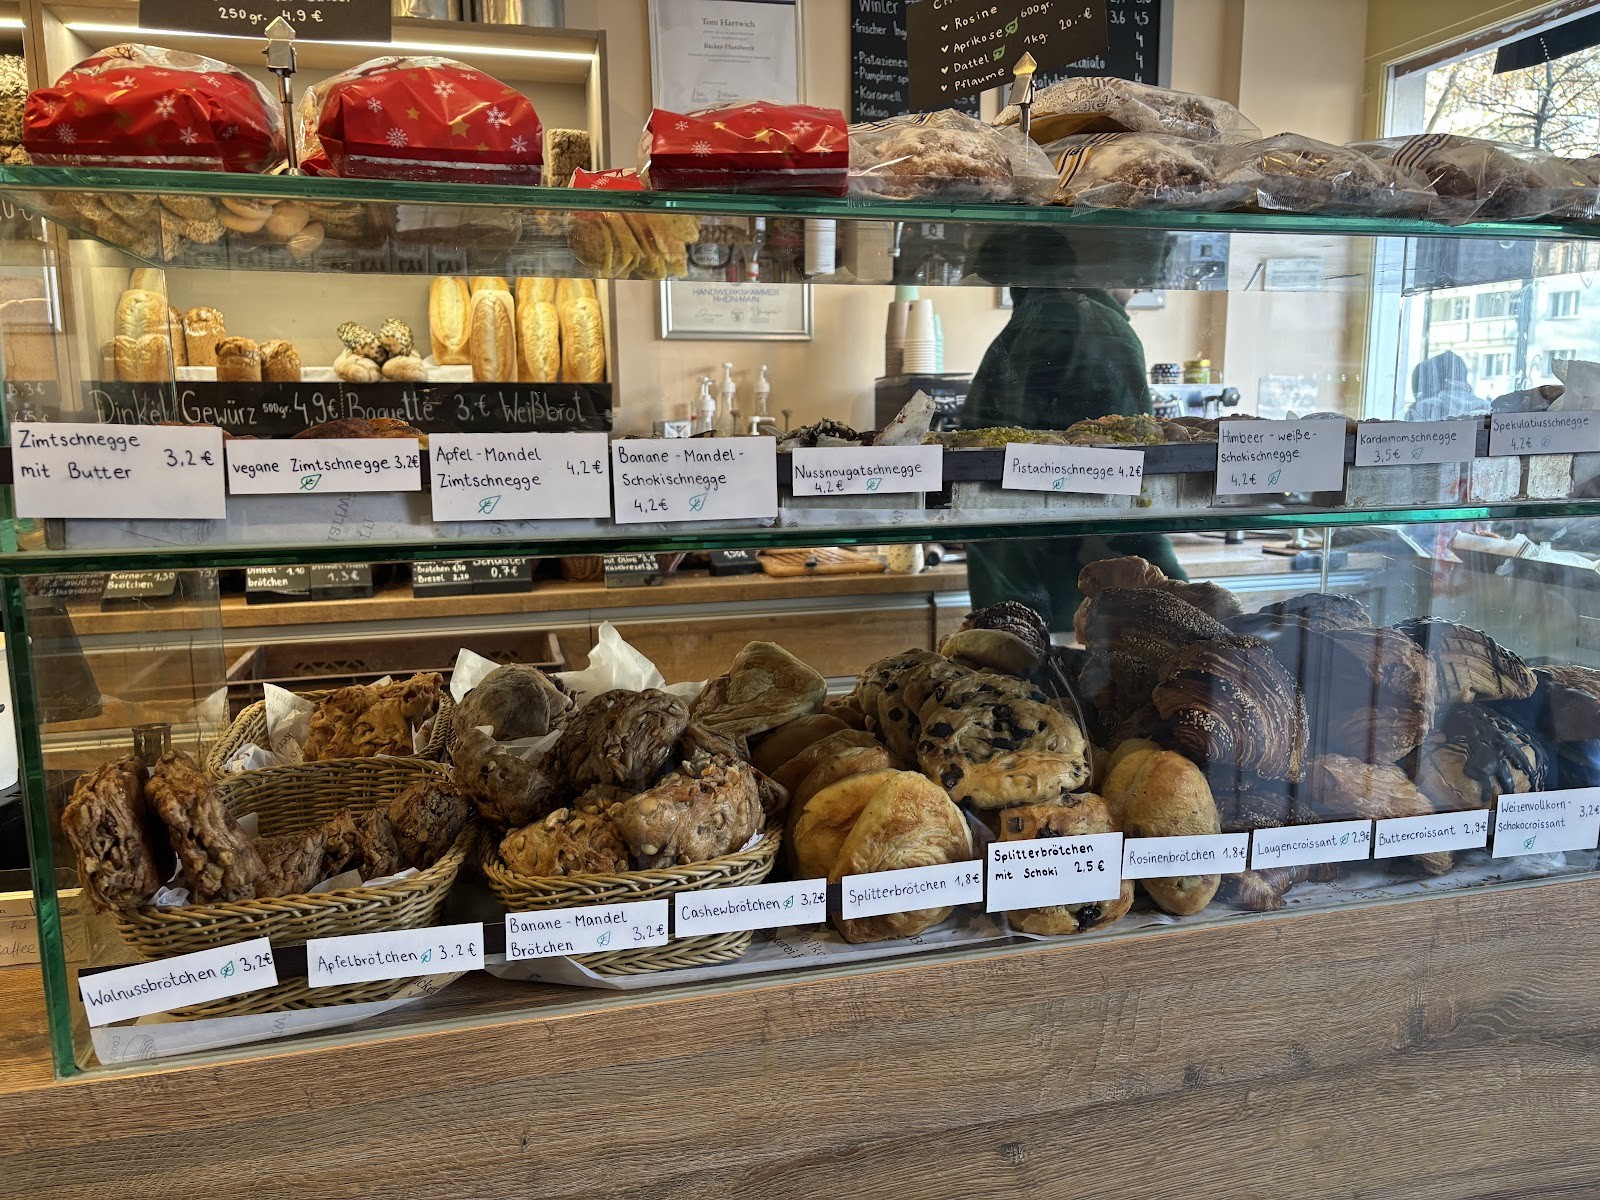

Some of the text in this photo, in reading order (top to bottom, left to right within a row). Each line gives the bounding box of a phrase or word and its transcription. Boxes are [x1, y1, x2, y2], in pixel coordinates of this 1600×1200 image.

[701, 17, 756, 28] Tom Hartwich
[955, 6, 998, 29] Rosine
[954, 28, 1003, 54] Aprikose
[1136, 31, 1144, 48] 4
[954, 53, 990, 73] Dattel
[1136, 52, 1144, 69] 4
[955, 67, 1005, 91] Pflaume
[692, 288, 779, 296] HANDWERKSKAMMER
[180, 390, 258, 425] Gewürz
[499, 391, 587, 424] Weißbrot
[1493, 416, 1589, 433] Spekulatiusschnegge
[18, 429, 141, 451] Zimtschnegge
[1360, 431, 1457, 446] Kardamomschnegge
[21, 462, 132, 479] mit Butter
[233, 463, 280, 478] vegane
[291, 457, 391, 474] Zimtschnegge
[795, 463, 922, 481] Nussnougatschnegge
[1012, 457, 1114, 480] Pistachioschnegge
[438, 473, 542, 491] Zimtschnegge
[622, 473, 727, 491] Schokischnegge
[107, 580, 154, 589] Brötchen
[248, 577, 288, 587] brötchen
[1498, 818, 1566, 832] Schokocroissant
[1379, 825, 1456, 846] Buttercroissant
[994, 844, 1094, 863] Splitterbrötchen
[1258, 835, 1338, 858] Laugencroissant
[1129, 849, 1215, 866] Rosinenbrötchen
[995, 870, 1013, 881] mit
[1023, 867, 1058, 879] Schoki
[849, 880, 946, 907] Splitterbrötchen
[681, 899, 781, 921] Cashewbrötchen
[0, 941, 37, 957] affee
[511, 941, 574, 958] Brötchen
[318, 950, 418, 975] Apfelbrötchen
[87, 967, 216, 1007] Walnussbrötchen
